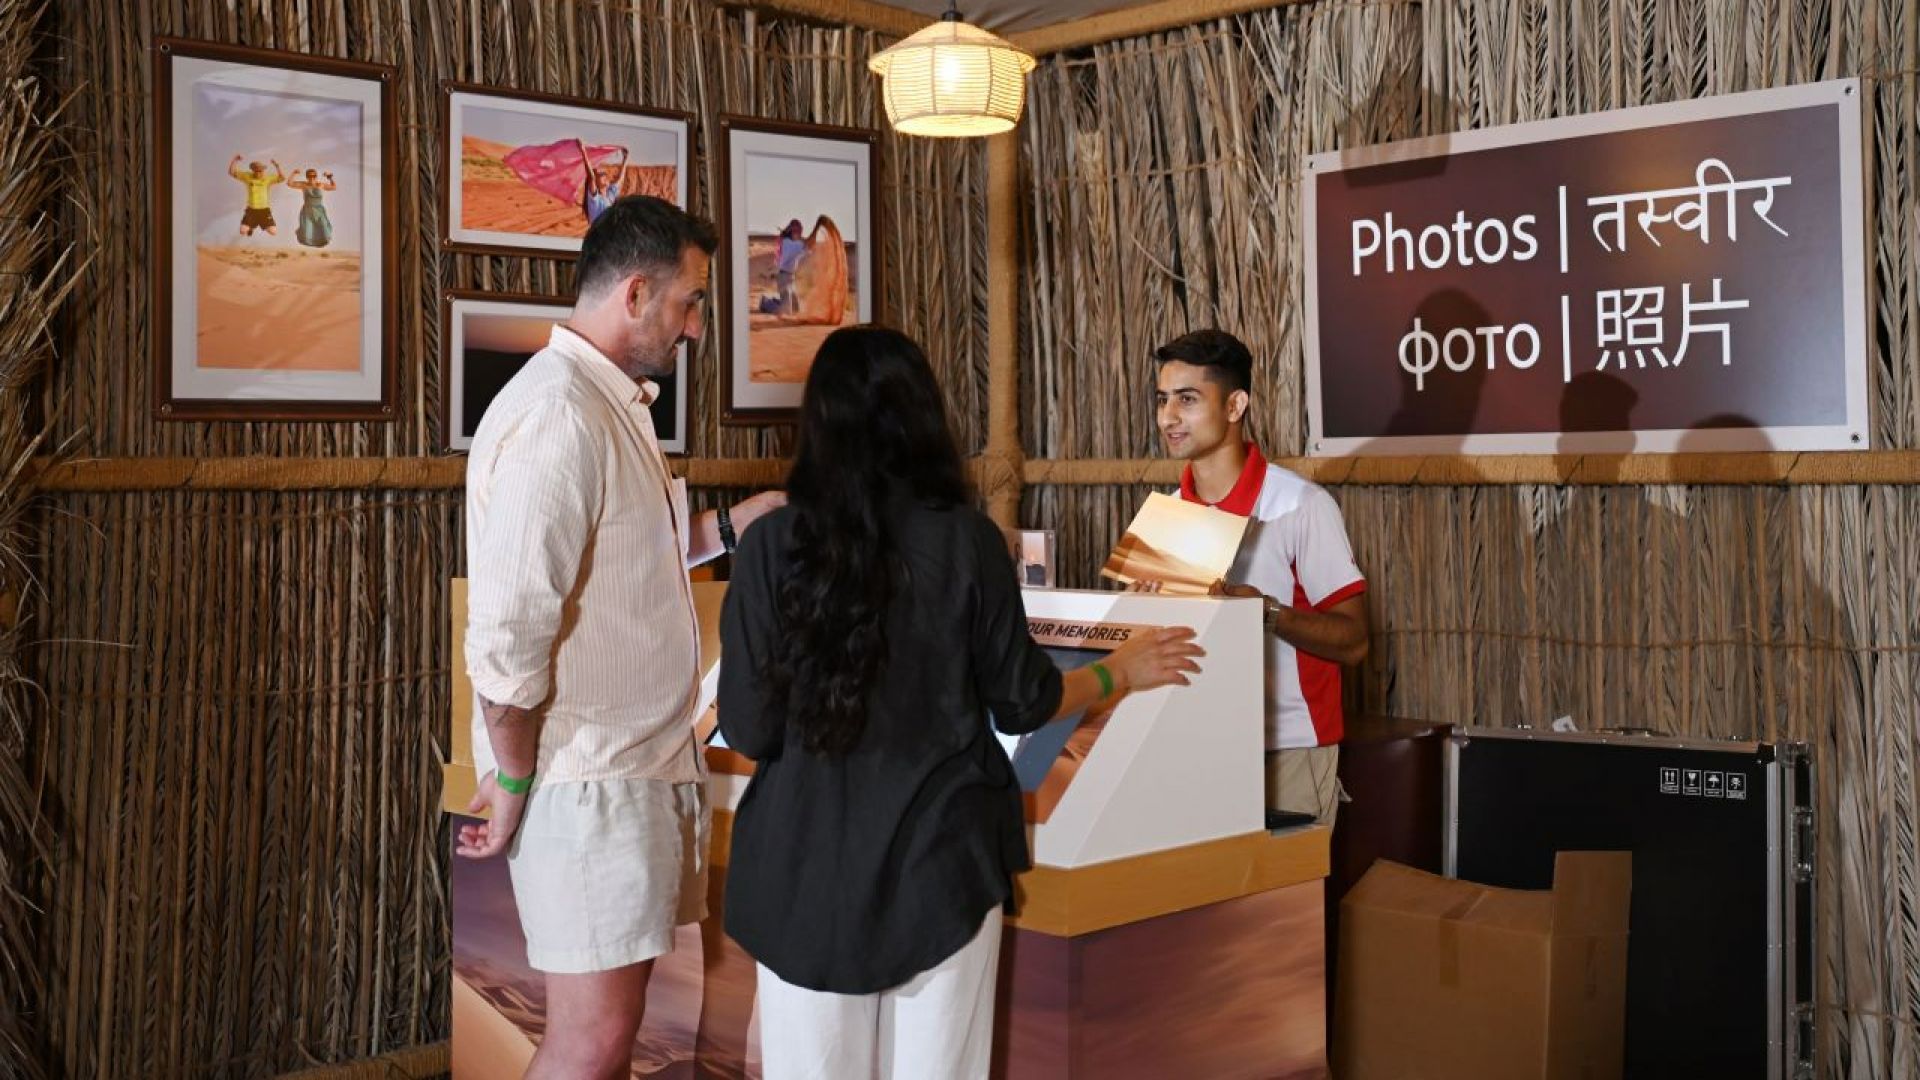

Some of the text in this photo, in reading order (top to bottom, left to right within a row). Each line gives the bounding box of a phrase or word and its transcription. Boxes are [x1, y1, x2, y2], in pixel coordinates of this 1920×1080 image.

[1586, 157, 1792, 252] तस्वीर
[1352, 210, 1538, 276] Photos
[1398, 317, 1541, 391] фото
[1595, 278, 1750, 371] 照片
[1055, 624, 1132, 641] MEMORIES
